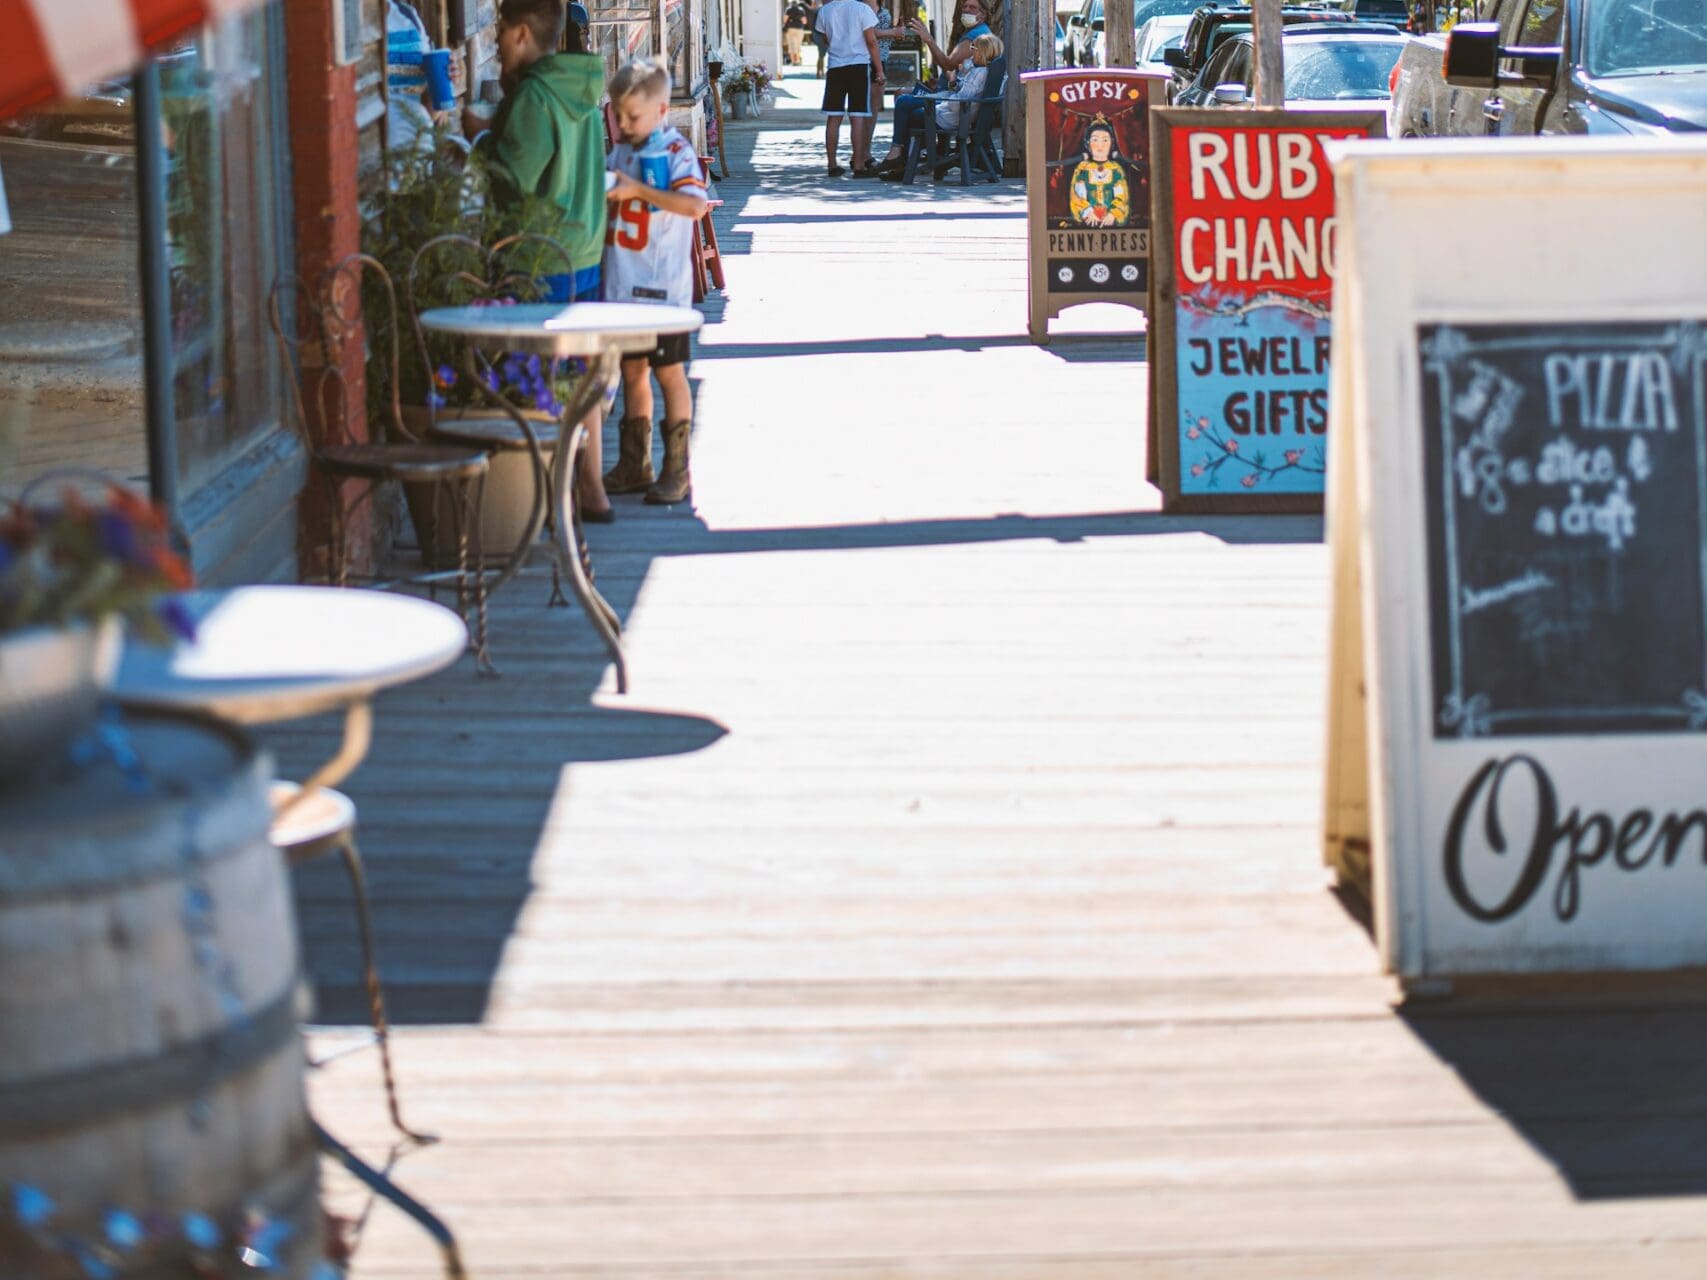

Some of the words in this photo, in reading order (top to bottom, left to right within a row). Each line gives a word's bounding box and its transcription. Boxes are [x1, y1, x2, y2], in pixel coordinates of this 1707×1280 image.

[1061, 80, 1128, 103] GYPSY
[1188, 131, 1361, 201] RUB
[1223, 388, 1328, 436] GIFTS
[1544, 352, 1680, 433] PIZZA
[1443, 752, 1707, 924] Open
